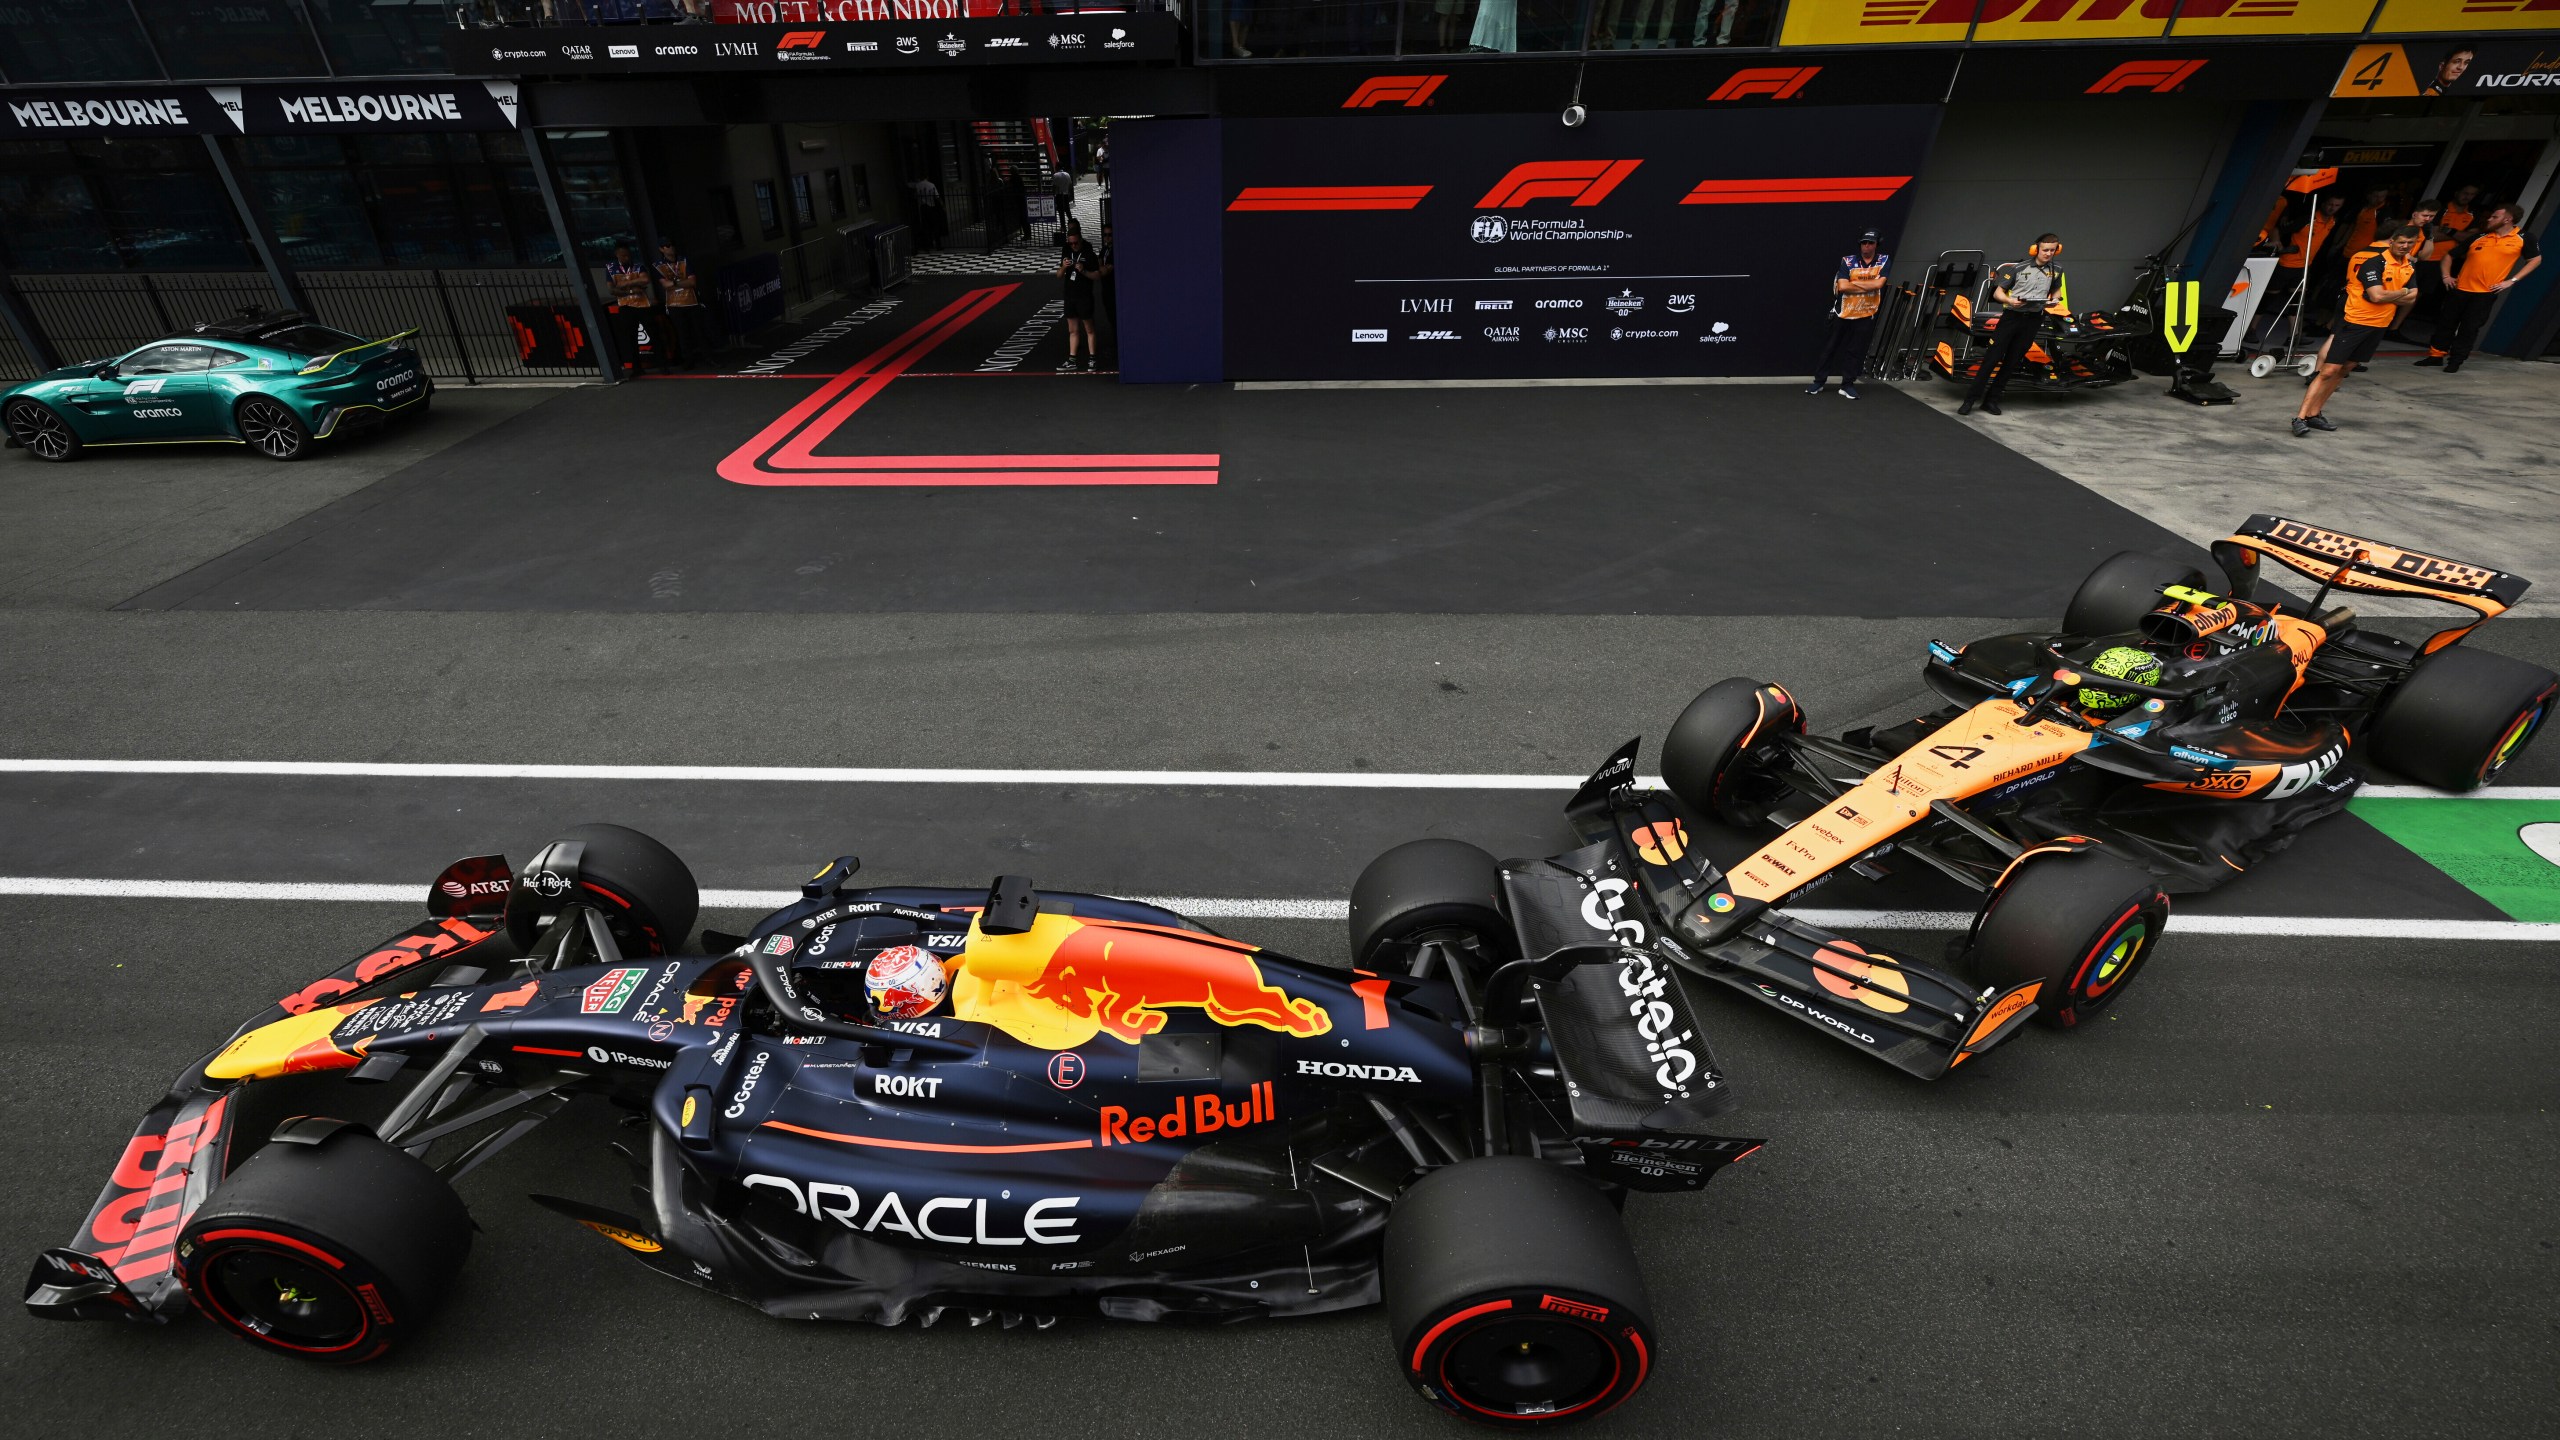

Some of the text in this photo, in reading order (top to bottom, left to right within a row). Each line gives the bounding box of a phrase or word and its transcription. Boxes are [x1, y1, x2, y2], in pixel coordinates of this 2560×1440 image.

[838, 0, 970, 22] CHANDON
[847, 42, 878, 51] PIRELLI
[896, 36, 918, 46] aws
[988, 38, 1024, 48] DHL
[1060, 34, 1086, 45] MSC
[1104, 41, 1135, 50] salesforce
[504, 49, 547, 59] crypto.com
[562, 45, 591, 56] QATAR
[611, 48, 636, 56] Lenovo
[655, 46, 698, 55] aramco
[715, 42, 759, 56] LVMH
[2084, 60, 2210, 93] F1
[2351, 52, 2393, 90] 4
[1342, 75, 1448, 108] F1
[1706, 67, 1822, 100] F1
[218, 101, 243, 113] MEL
[278, 94, 463, 124] MELBOURNE
[493, 95, 518, 107] MEL
[8, 99, 190, 128] MELBOURNE
[2344, 150, 2398, 164] DEWALT
[1473, 159, 1645, 208] F1
[1510, 218, 1585, 230] FIA Formula 1
[1510, 230, 1548, 240] World
[1549, 230, 1624, 241] Championship
[752, 286, 765, 300] PARC
[1668, 294, 1696, 305] aws
[1400, 298, 1454, 313] LVMH
[1474, 300, 1514, 310] PIRELLI
[1535, 299, 1583, 309] aramco
[1607, 299, 1643, 307] Heineken
[1355, 331, 1385, 340] Lenovo
[1413, 330, 1458, 340] DHL
[1484, 326, 1520, 337] QATAR
[1558, 328, 1589, 338] MSC
[1625, 330, 1679, 339] crypto.com
[1700, 334, 1737, 344] salesforce
[737, 326, 852, 374] CHANDON
[974, 326, 1052, 372] CHANDON
[376, 370, 414, 391] aramco
[134, 408, 182, 418] aramco
[2194, 606, 2234, 632] allwyn
[2220, 710, 2238, 724] CISCO
[1928, 745, 1986, 770] 4
[2172, 750, 2210, 765] allwyn
[1993, 762, 2034, 782] RICHARD
[2036, 752, 2064, 769] MILLE
[1891, 770, 1925, 794] Hilton
[2006, 770, 2056, 794] DP WORLD
[1812, 822, 1844, 846] webex
[1786, 840, 1816, 862] FxPro
[1761, 854, 1797, 876] DEWALT
[546, 877, 572, 890] Rock
[1744, 870, 1770, 888] PIRELLI
[1786, 870, 1834, 904] JACK DANIEL'S
[470, 880, 510, 895] AT&T
[816, 908, 838, 924] AT&T
[848, 902, 883, 914] ROKT
[892, 908, 936, 921] AVATRADE
[766, 934, 782, 953] TAG
[776, 936, 792, 955] HEUER
[833, 960, 862, 968] Mobil
[605, 971, 642, 1009] TAG
[776, 966, 797, 999] ORACLE
[588, 971, 622, 1011] HEUER
[632, 961, 681, 1022] ORACLE
[439, 991, 474, 1020] VISA
[704, 996, 737, 1028] Red
[1351, 979, 1391, 1030] 1
[1990, 997, 2028, 1020] workday
[414, 1005, 439, 1026] AT&T
[1780, 994, 1876, 1045] DP WORLD
[890, 1022, 942, 1038] VISA
[782, 1036, 814, 1045] Mobil
[480, 1060, 503, 1073] FIA
[1296, 1060, 1422, 1083] HONDA
[734, 1051, 770, 1104] Gate.io
[874, 1074, 943, 1098] ROKT
[1100, 1080, 1275, 1147] Red Bull
[1575, 1136, 1698, 1150] Mobil
[1616, 1152, 1698, 1173] Heineken
[1640, 1166, 1664, 1177] 0.0
[743, 1173, 1081, 1245] ORACLE
[1146, 1245, 1186, 1258] HEXAGON
[43, 1252, 118, 1285] Mobil
[958, 1260, 1017, 1272] SIEMENS
[356, 1283, 395, 1325] PIRELLI
[1539, 1294, 1609, 1323] PIRELLI
